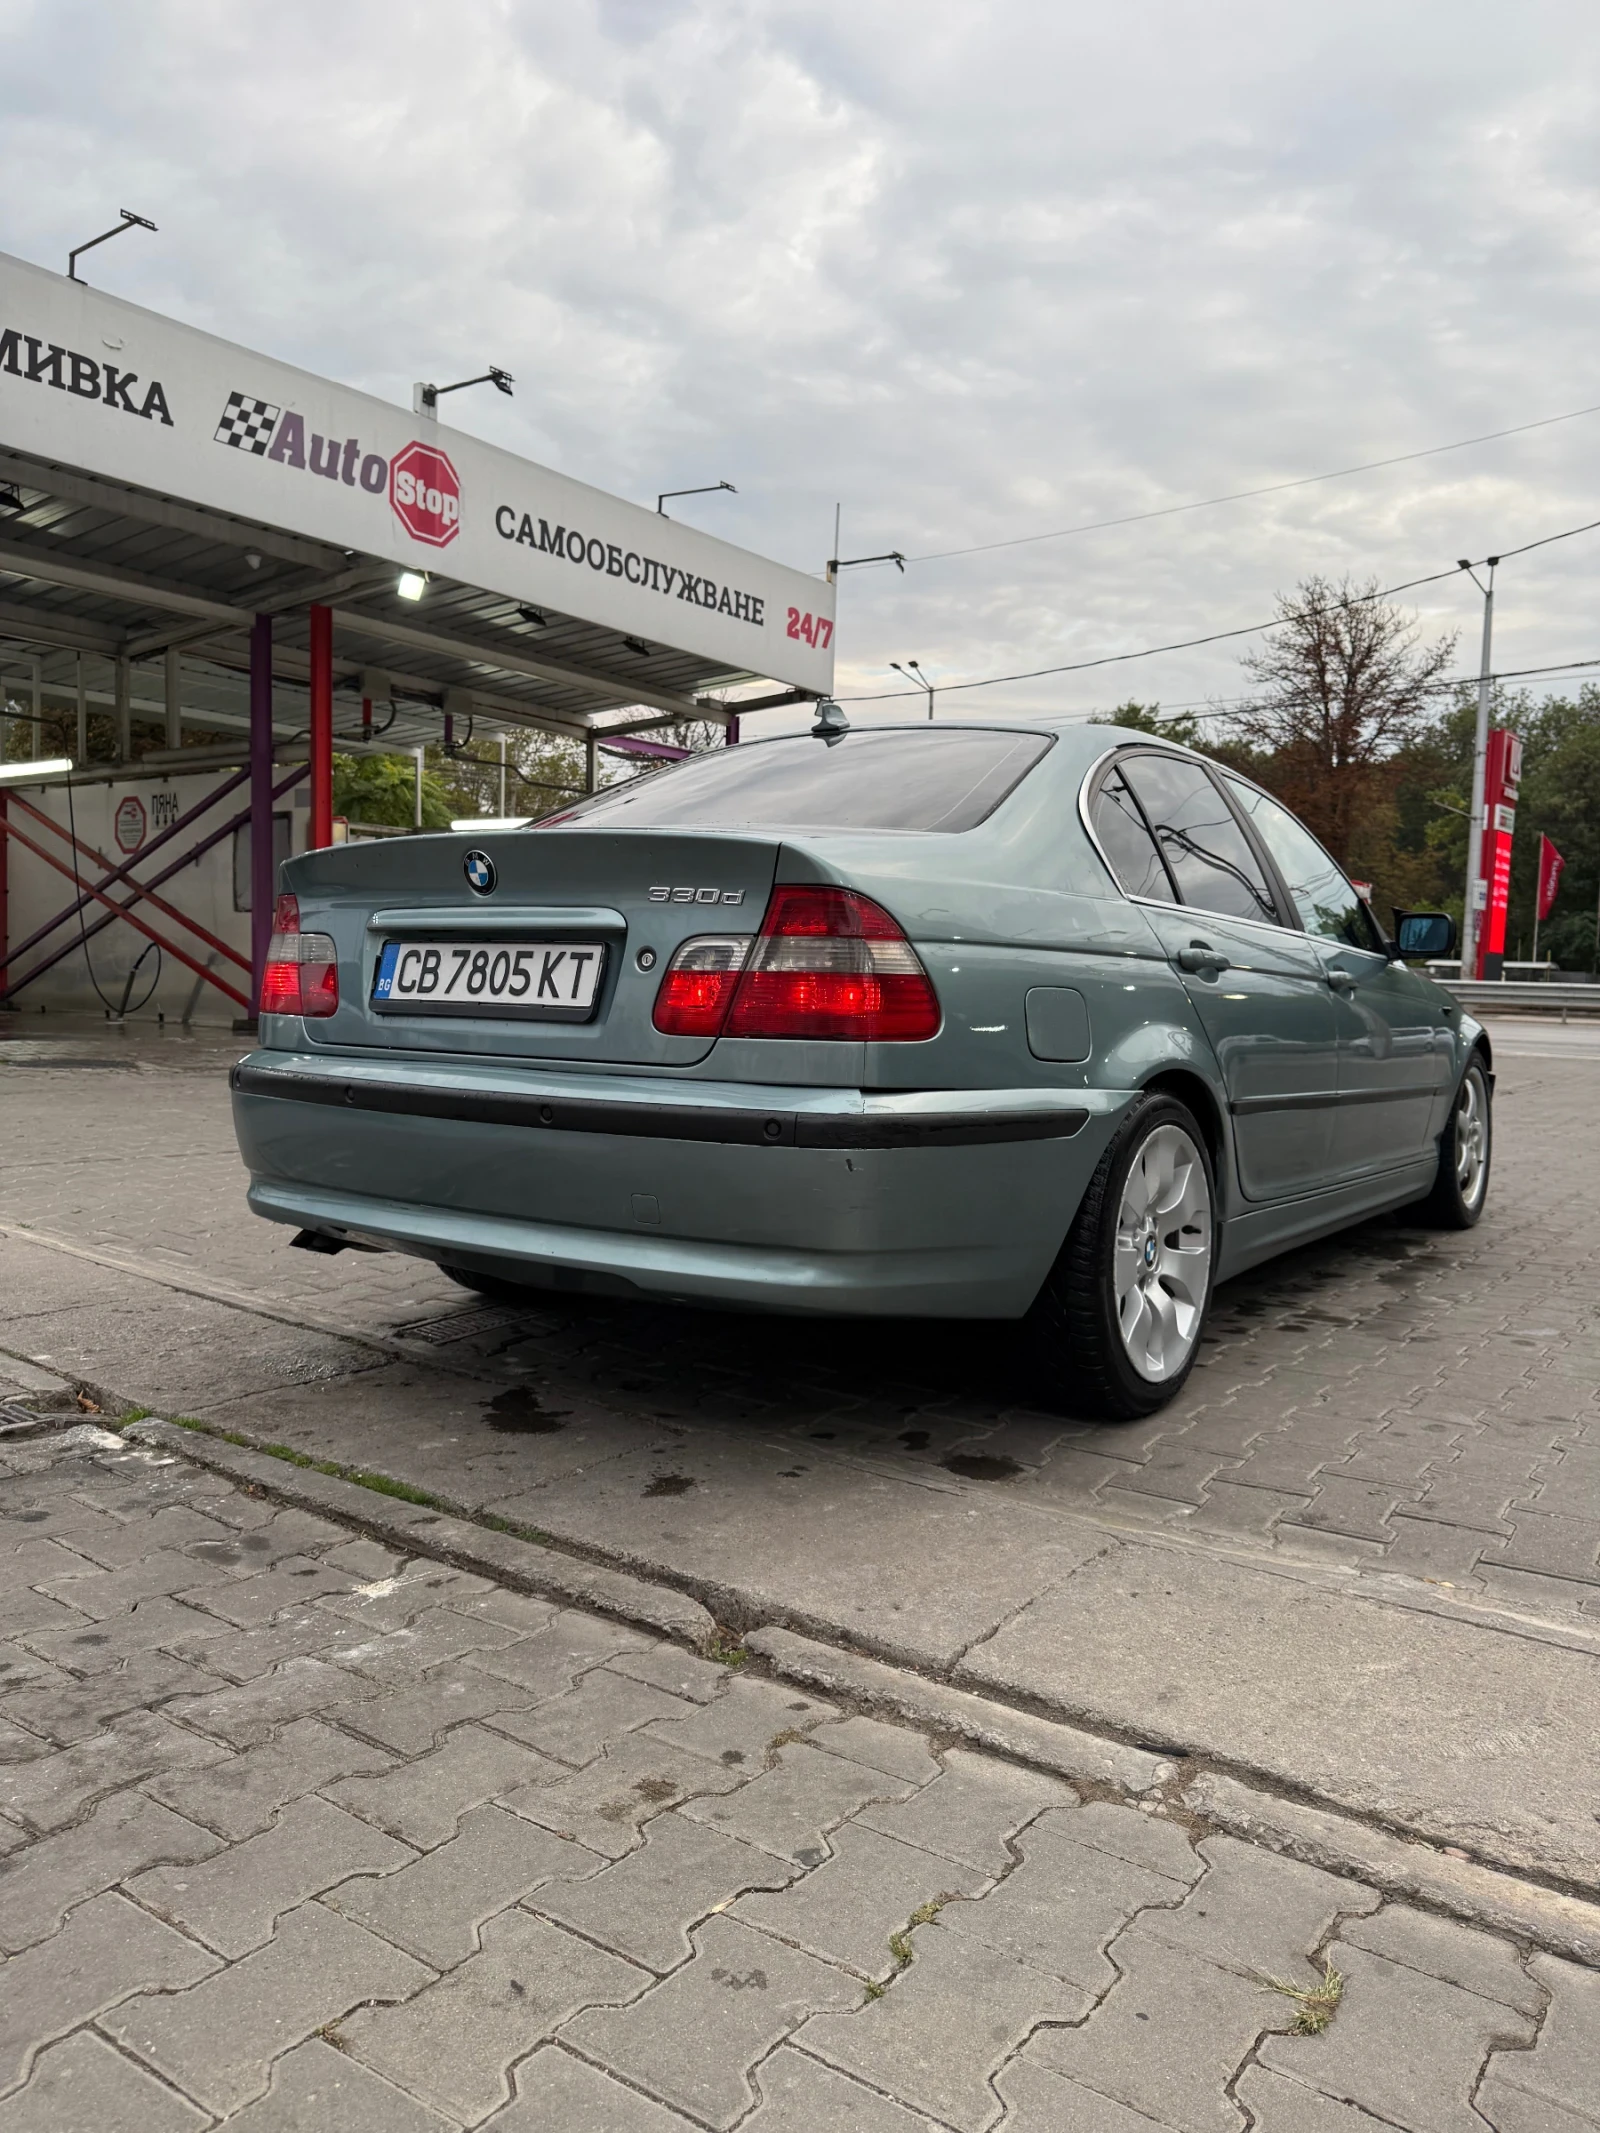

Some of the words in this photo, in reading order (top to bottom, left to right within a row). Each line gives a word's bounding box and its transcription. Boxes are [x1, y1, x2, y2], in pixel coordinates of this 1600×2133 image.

[267, 411, 388, 494] Auto
[396, 470, 459, 526] Stop
[495, 505, 765, 626] САМООБСЛУЖВАНЕ
[787, 607, 833, 649] 24/7
[151, 792, 179, 815] ПЯНА
[647, 886, 746, 906] 330d
[378, 978, 391, 991] BG
